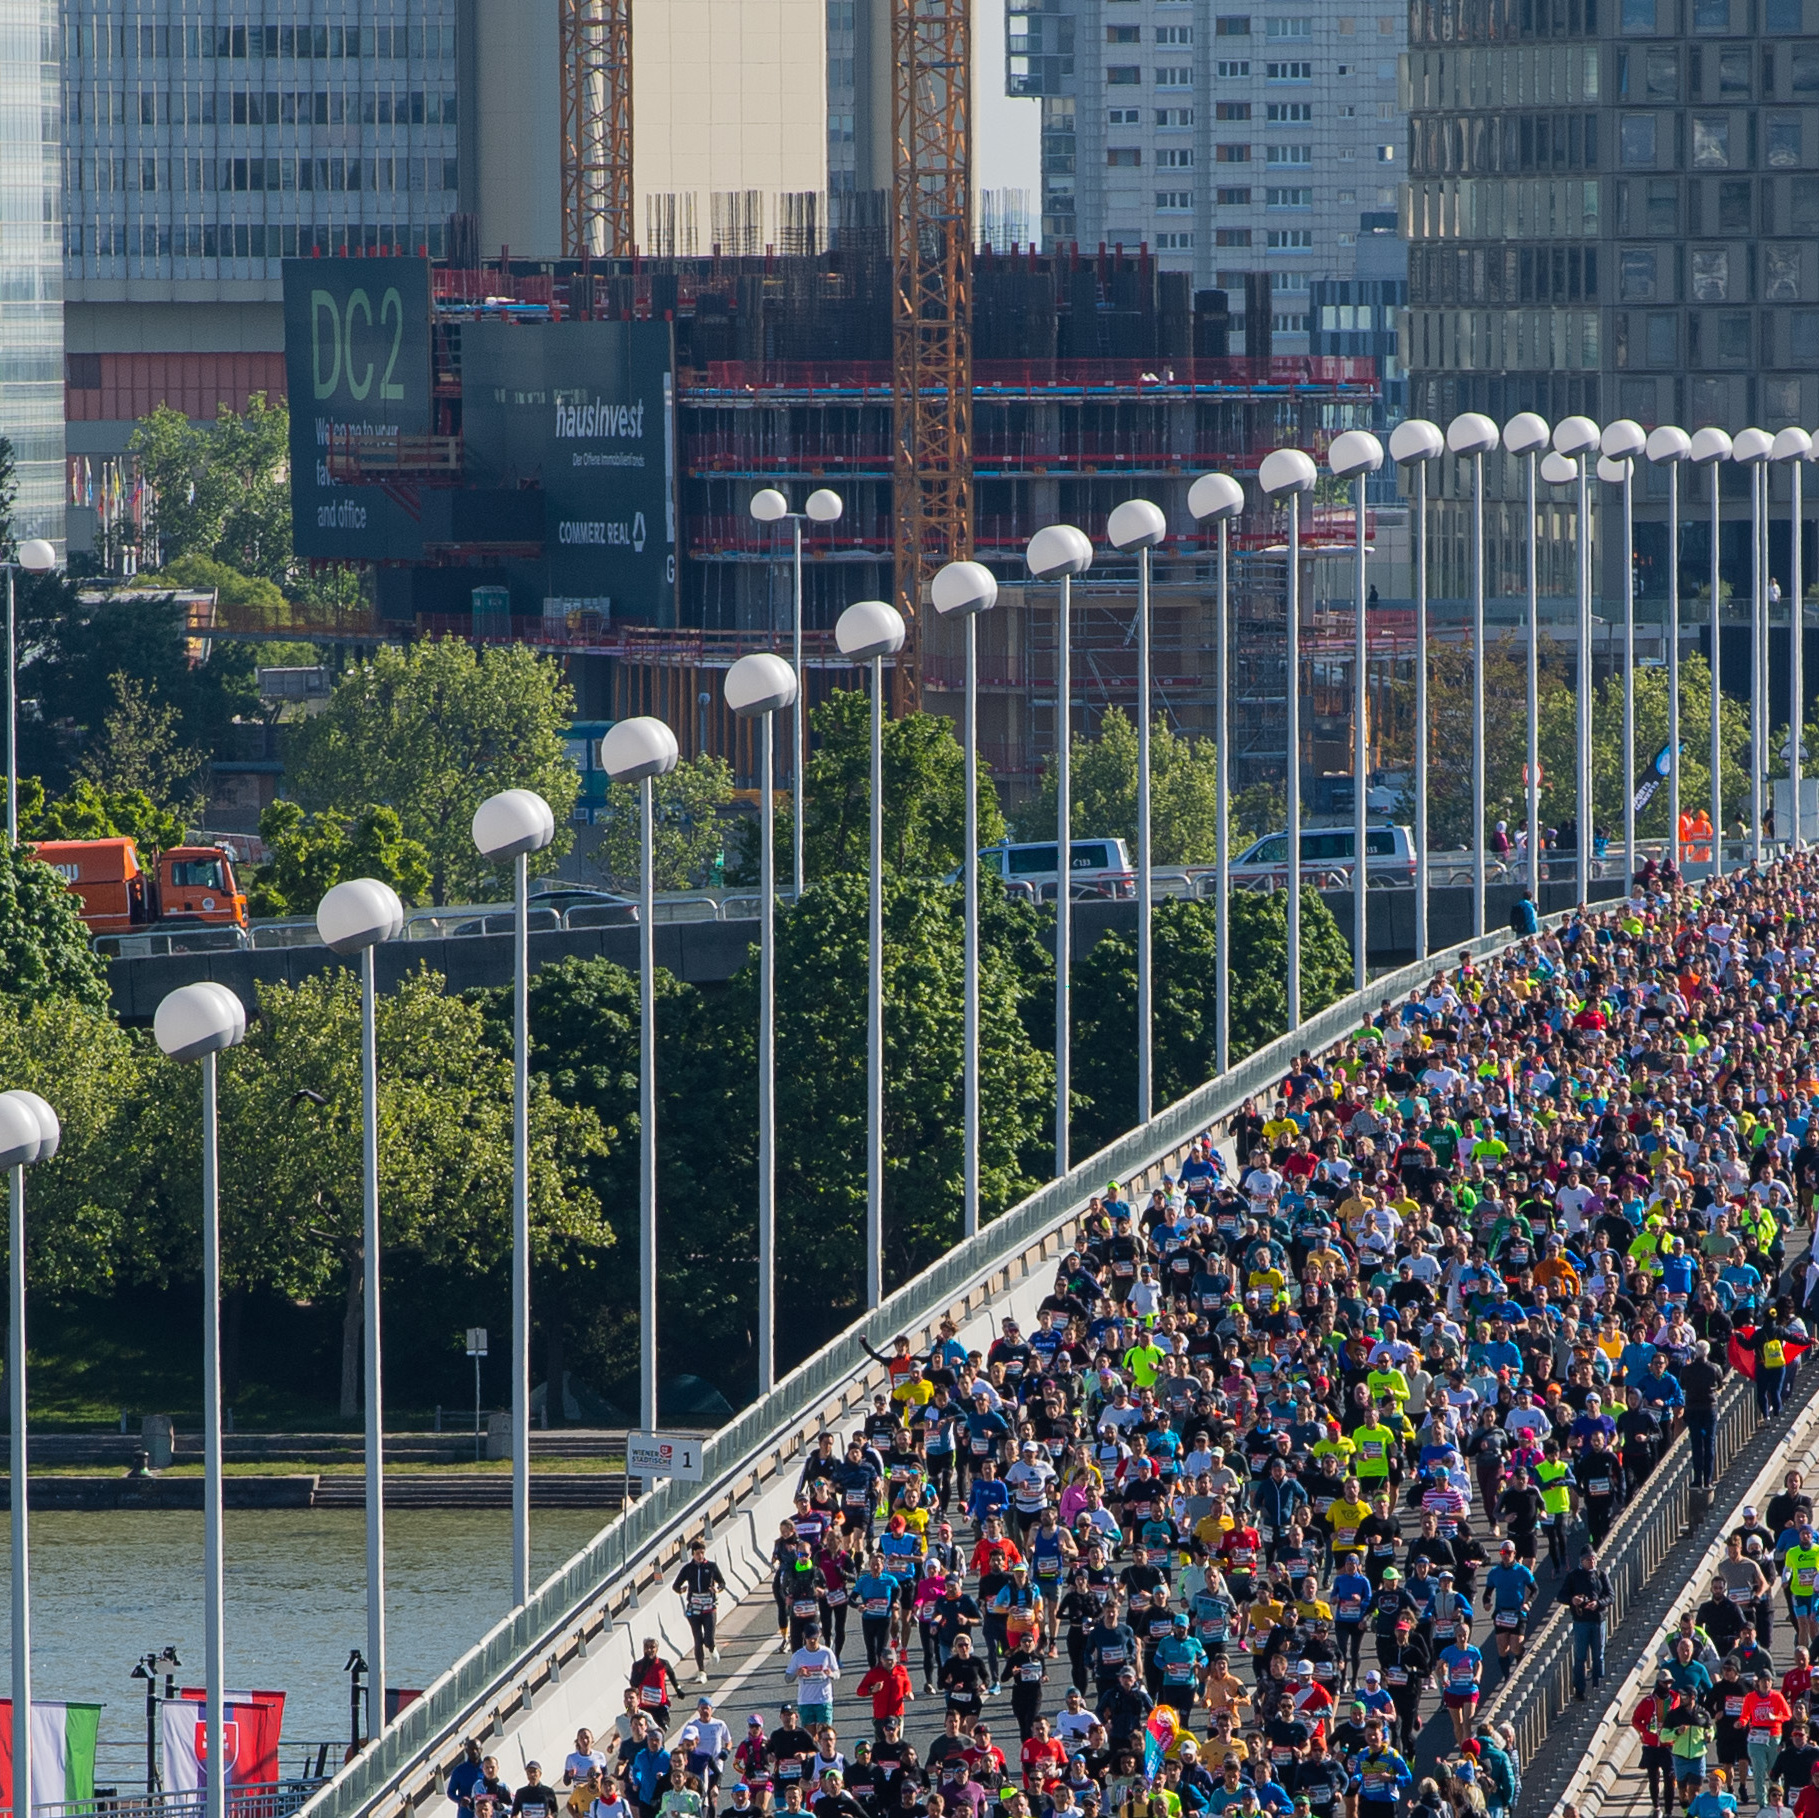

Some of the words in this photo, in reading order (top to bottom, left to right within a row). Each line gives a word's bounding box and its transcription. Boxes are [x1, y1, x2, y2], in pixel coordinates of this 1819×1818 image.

[317, 501, 336, 528] and
[337, 500, 366, 528] office
[559, 521, 606, 544] COMMERZ
[607, 522, 630, 545] REAL
